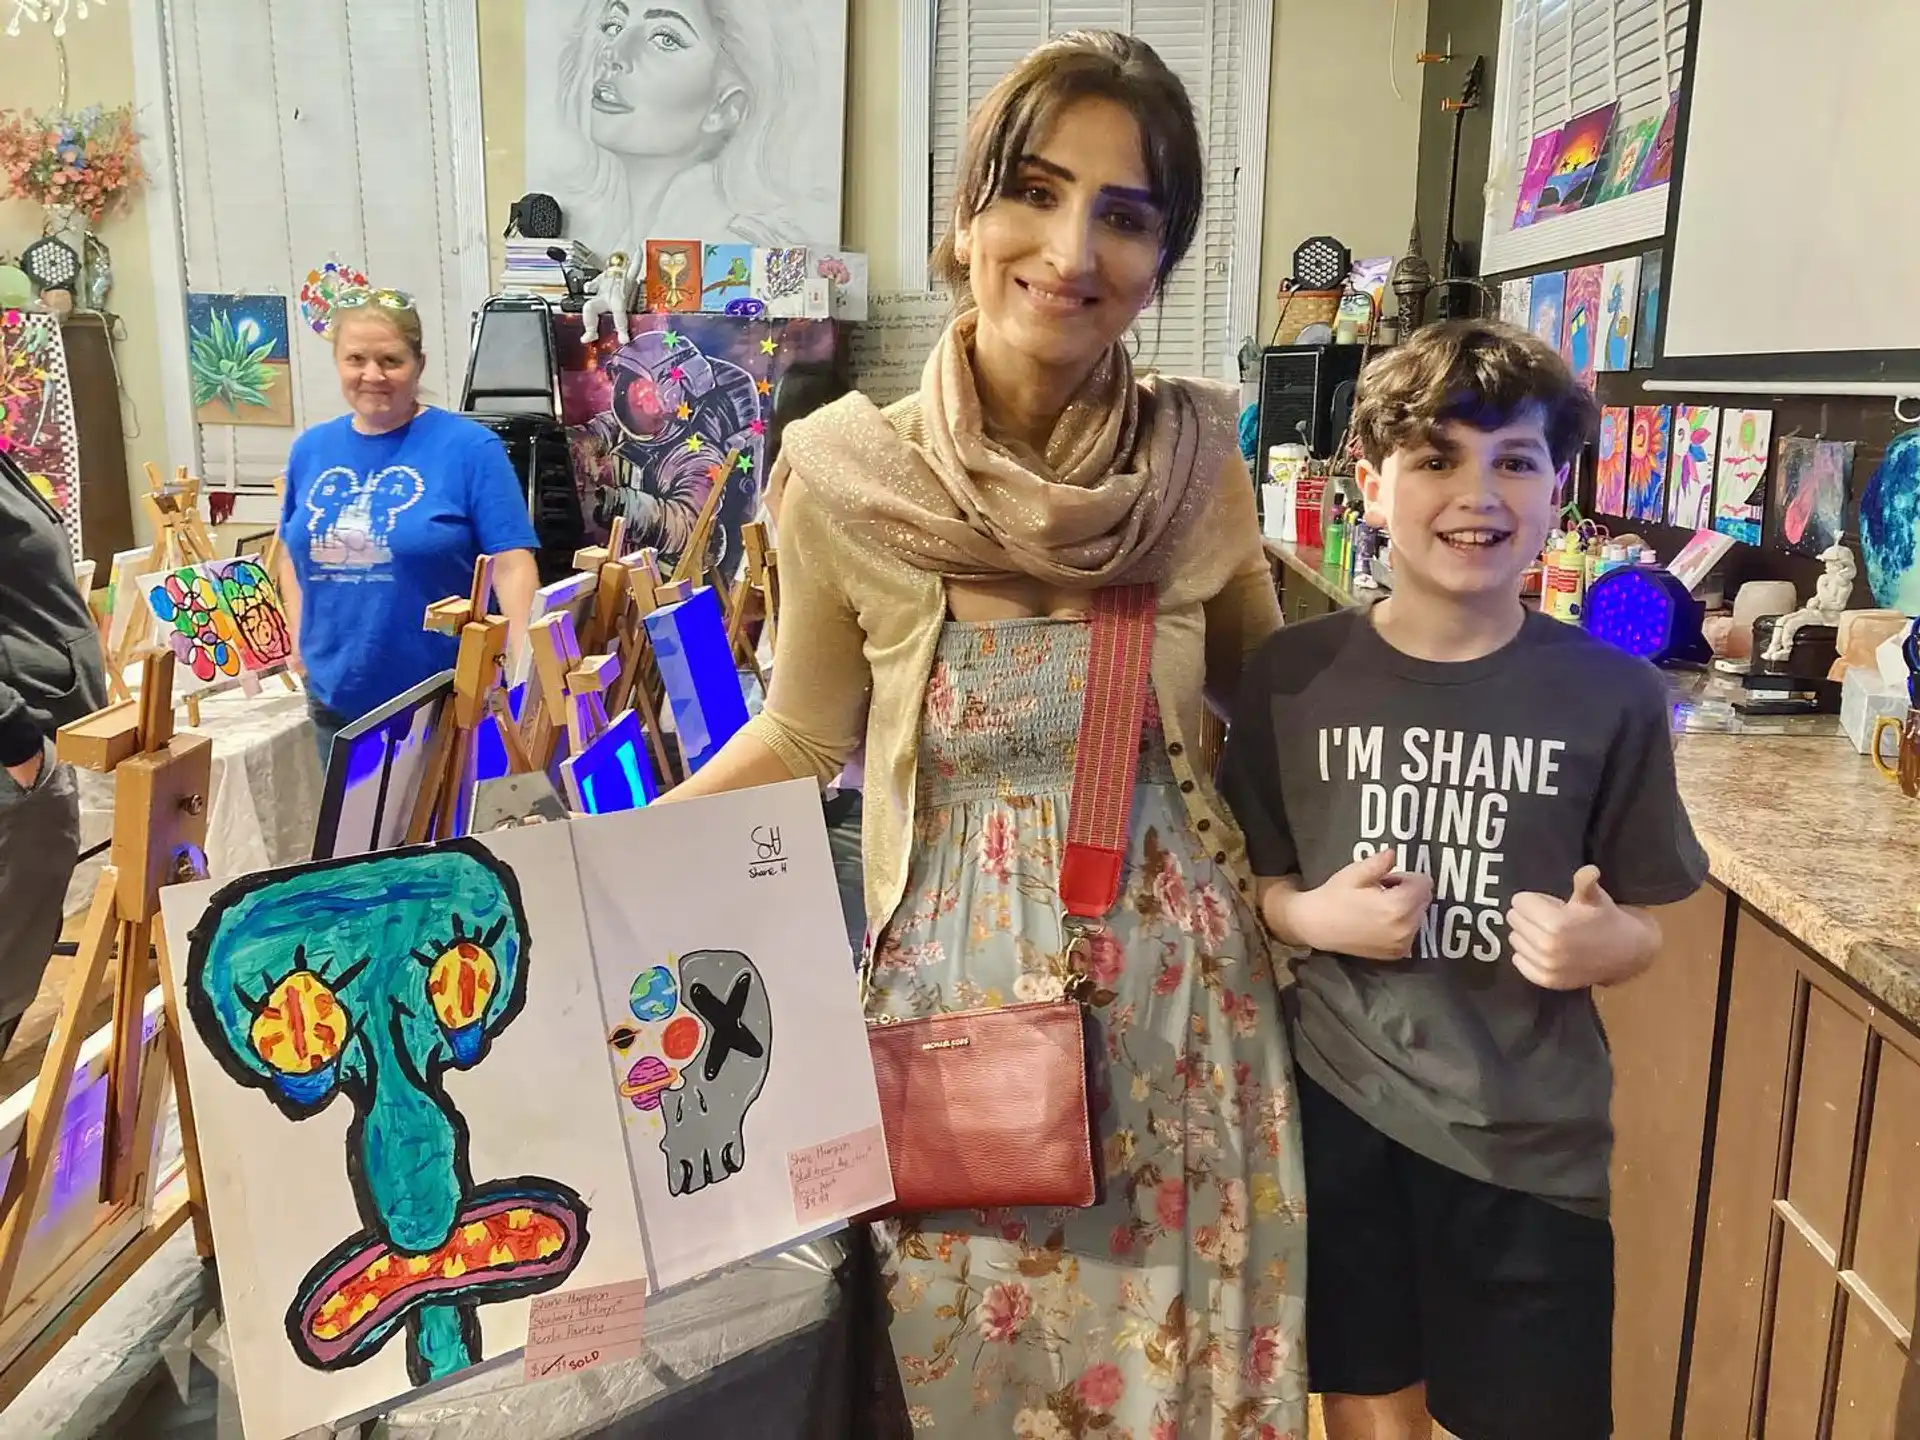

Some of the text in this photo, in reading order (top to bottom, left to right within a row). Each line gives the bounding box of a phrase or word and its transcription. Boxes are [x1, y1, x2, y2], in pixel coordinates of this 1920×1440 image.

[1318, 726, 1566, 795] I'M SHANE
[1360, 783, 1509, 849] DOING
[568, 1350, 600, 1371] SOLD
